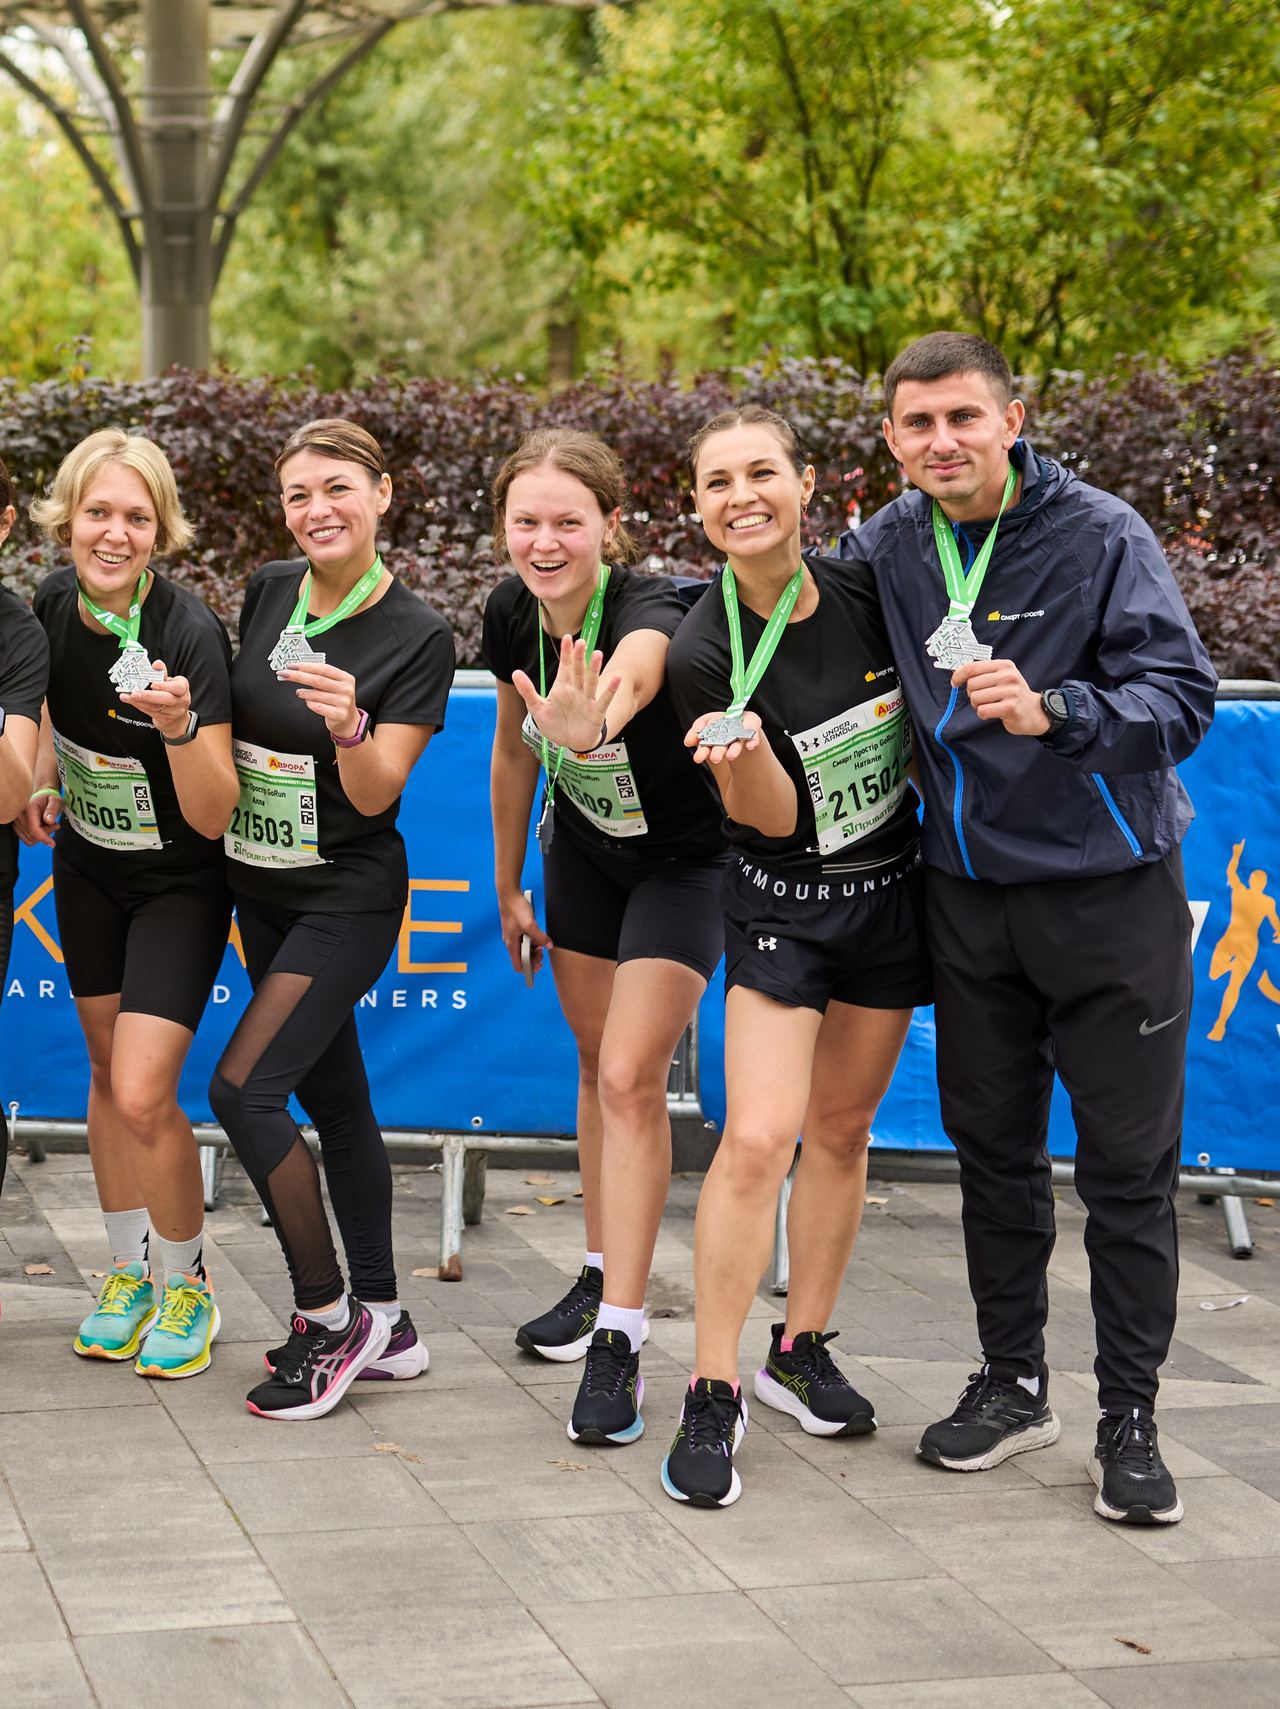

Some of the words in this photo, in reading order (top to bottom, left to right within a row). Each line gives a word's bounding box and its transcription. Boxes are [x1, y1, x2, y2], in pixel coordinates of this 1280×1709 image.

[822, 721, 850, 739] UNDER
[824, 723, 859, 744] ARMOUR
[833, 754, 853, 769] Смарт
[853, 743, 879, 758] Простір
[880, 732, 897, 746] GoRun
[855, 754, 882, 770] Наталія
[270, 759, 305, 772] АВРОРА
[267, 788, 287, 798] GoRun
[562, 777, 613, 818] 1509
[829, 757, 901, 822] 21502
[69, 789, 132, 831] 21505
[230, 806, 294, 848] 21503
